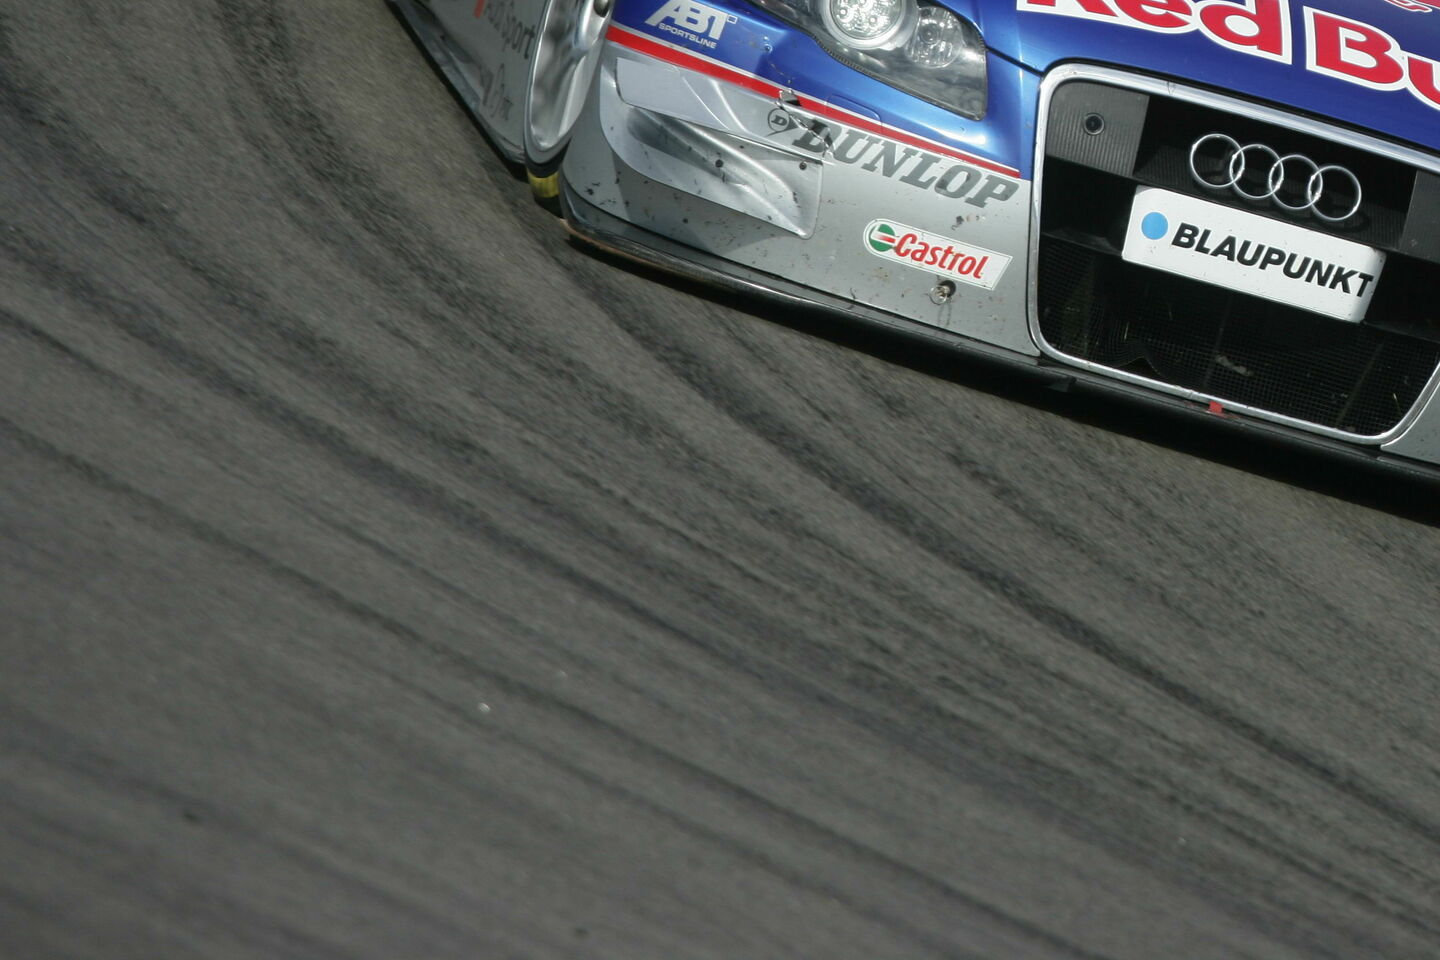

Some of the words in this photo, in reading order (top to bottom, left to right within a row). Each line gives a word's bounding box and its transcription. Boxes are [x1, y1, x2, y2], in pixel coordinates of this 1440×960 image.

[658, 22, 718, 50] SPORTSLINE
[791, 119, 1020, 209] DUNLOP
[893, 232, 990, 280] Castrol
[1171, 222, 1375, 298] BLAUPUNKT
